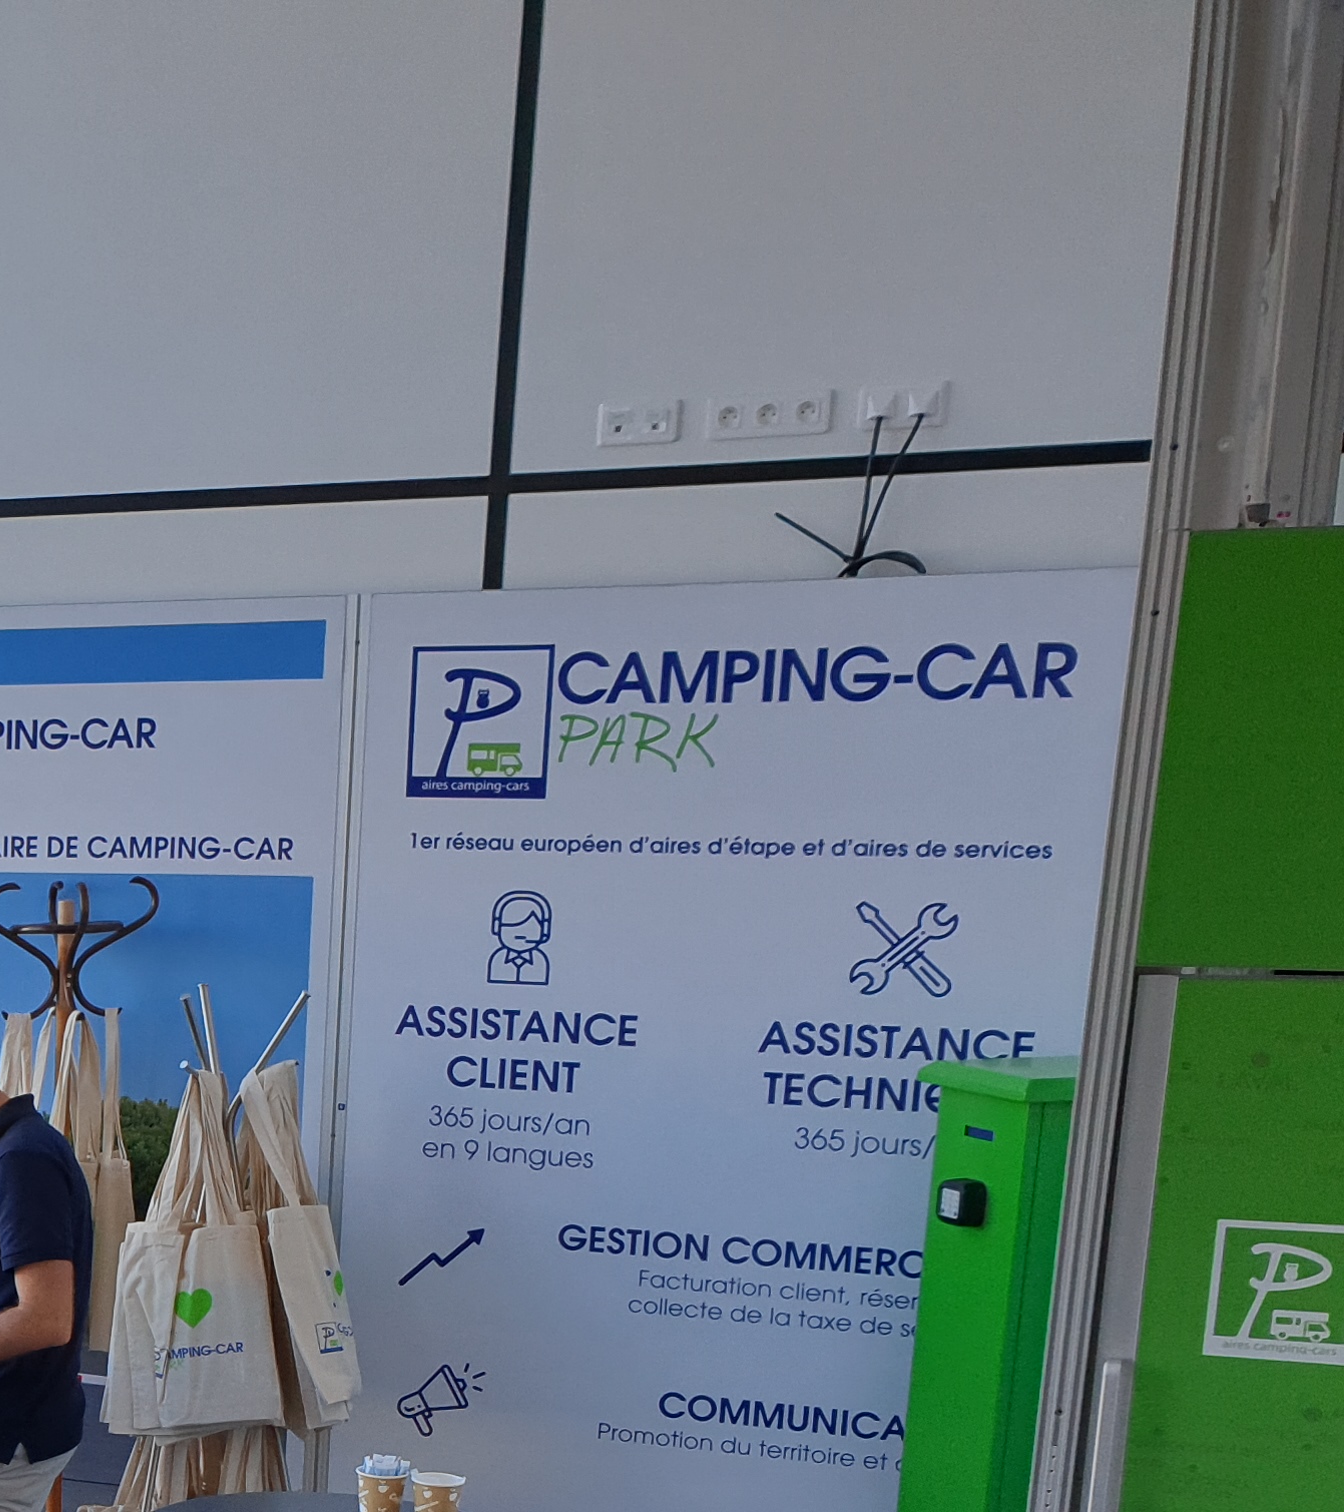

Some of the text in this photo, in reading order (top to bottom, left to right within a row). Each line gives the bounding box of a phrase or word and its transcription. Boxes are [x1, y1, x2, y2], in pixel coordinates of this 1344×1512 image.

[557, 642, 1078, 705] CAMPING-CAR
[558, 711, 720, 772] PARK
[421, 779, 530, 793] aires camping-cars
[47, 836, 78, 860] DE
[87, 836, 294, 862] CAMPING-CAR
[410, 831, 1053, 860] 1er réseau européen d'aires d'étape et d'aires de services
[395, 1004, 639, 1047] ASSISTANCE
[758, 1020, 1036, 1061] ASSISTANCE
[446, 1055, 581, 1093] CLIENT
[428, 1105, 591, 1136] 365 jours/an
[794, 1127, 845, 1151] 365
[422, 1139, 594, 1171] en 9 langues
[558, 1223, 710, 1262] GESTION
[638, 1269, 772, 1298] Facturation
[779, 1281, 850, 1306] client,
[627, 1298, 723, 1321] collecte
[730, 1305, 762, 1324] de
[769, 1307, 791, 1327] la
[798, 1309, 852, 1332] taxe
[859, 1316, 893, 1336] de
[1221, 1340, 1337, 1357] aires camping-cars
[658, 1391, 905, 1442] COMMUNICA
[597, 1422, 713, 1451] Promotion
[720, 1436, 751, 1456] du
[759, 1439, 855, 1467] territoire
[862, 1453, 888, 1471] et
